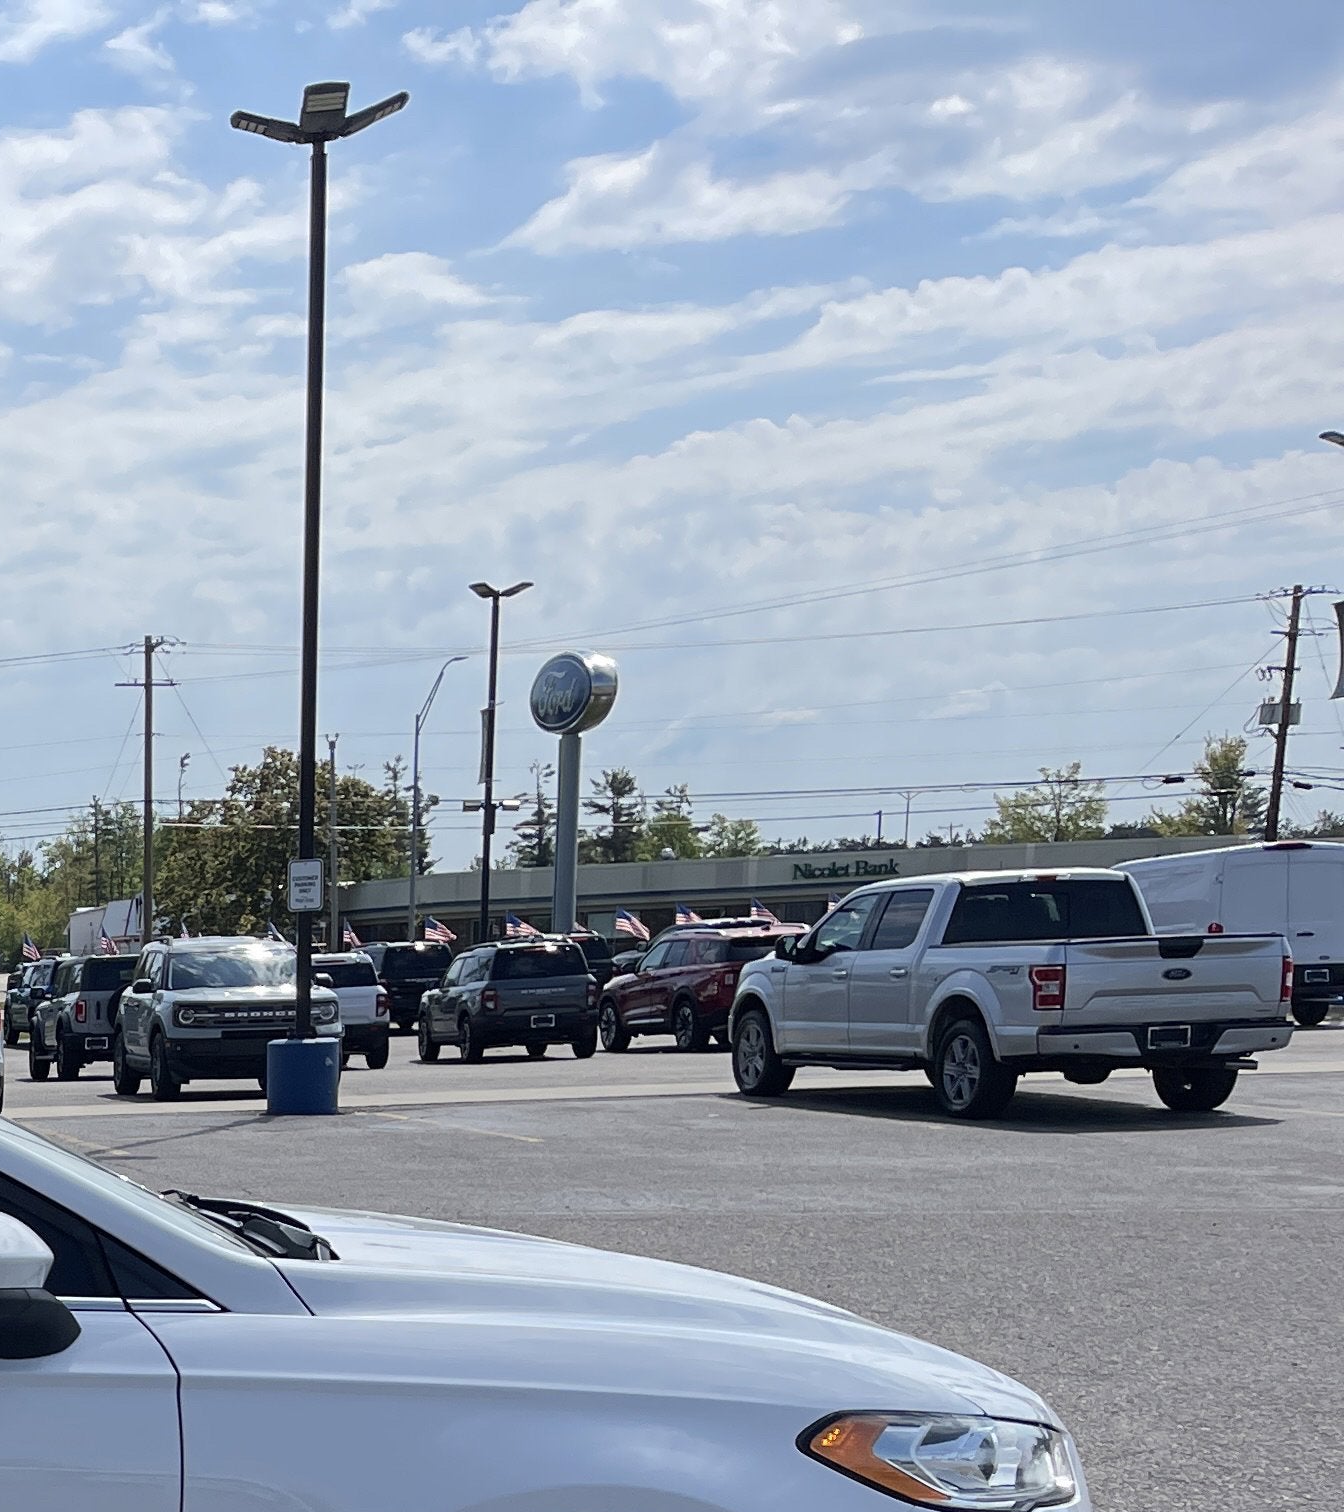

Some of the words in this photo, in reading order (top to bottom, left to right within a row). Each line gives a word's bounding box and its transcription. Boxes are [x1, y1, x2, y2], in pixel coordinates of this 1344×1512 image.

[537, 670, 578, 717] Ford
[792, 862, 850, 880] Nicolet
[854, 858, 900, 877] Bank
